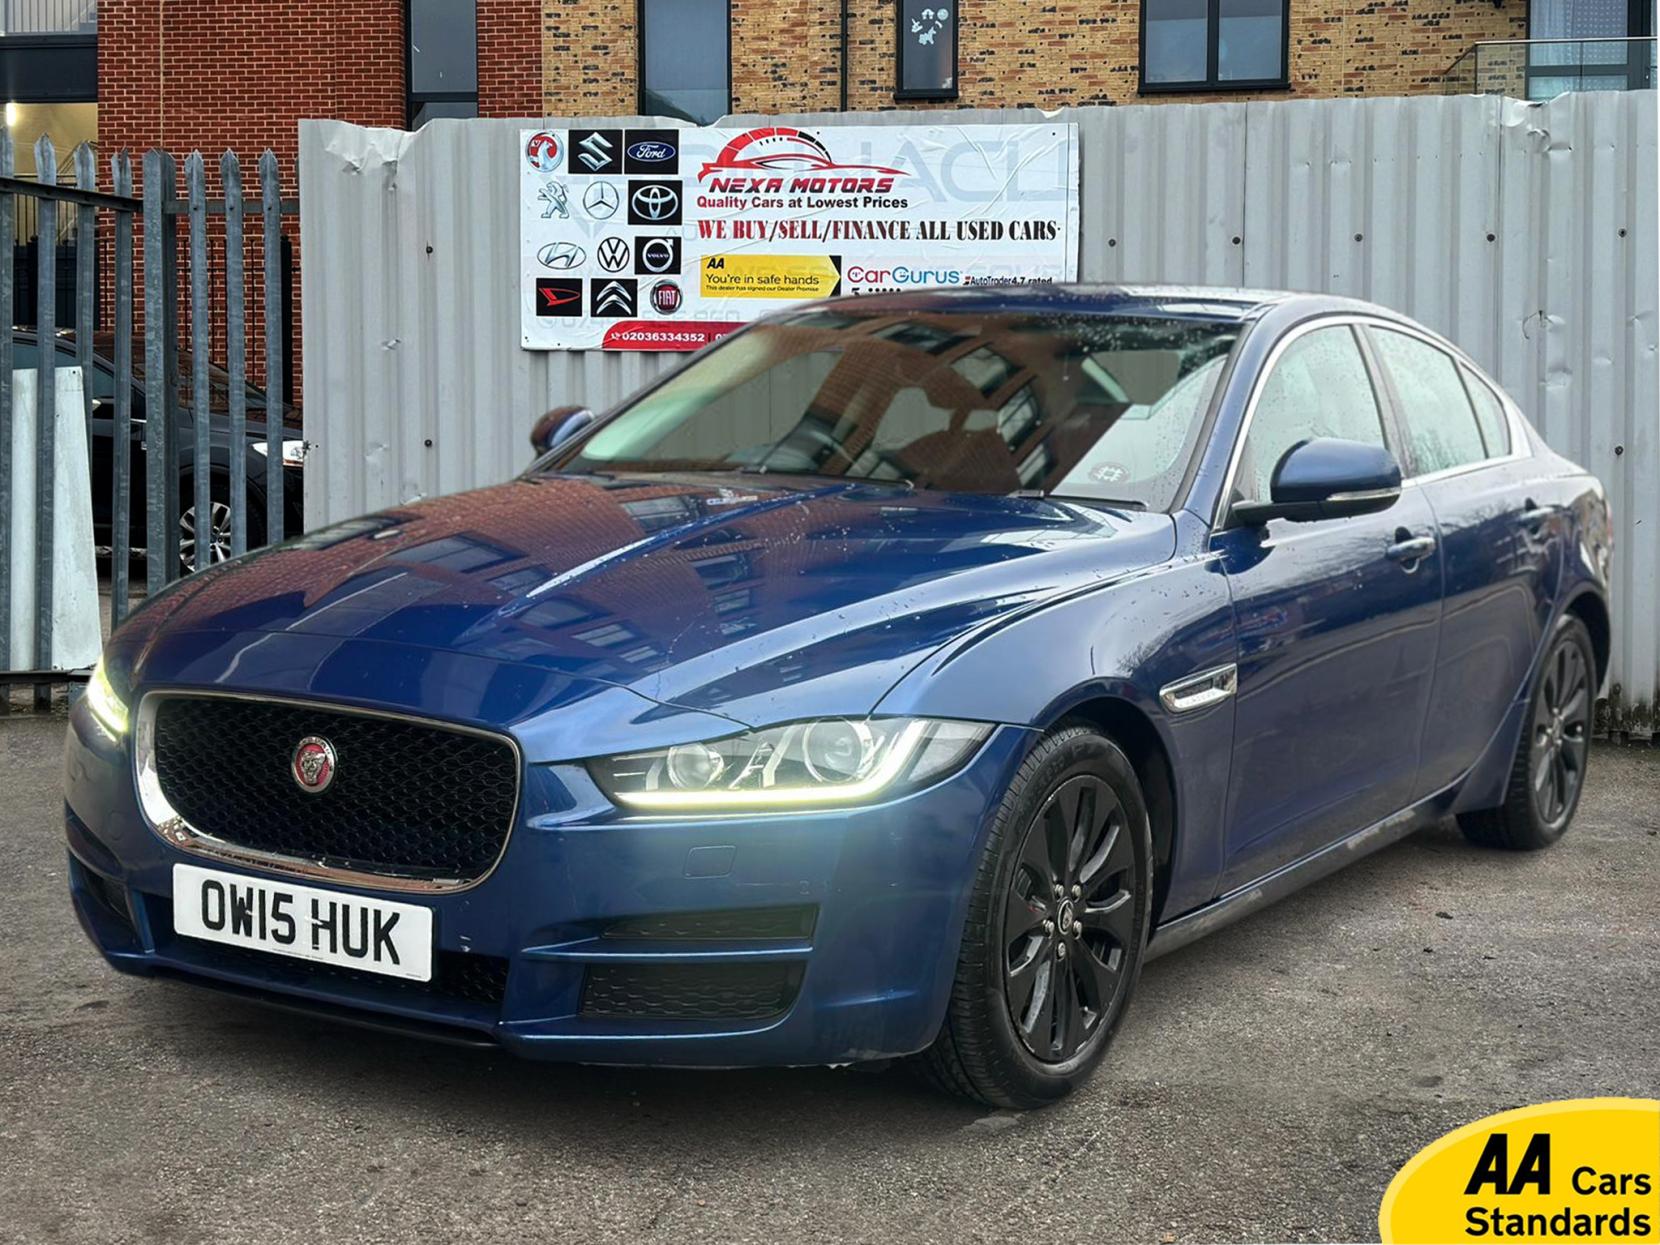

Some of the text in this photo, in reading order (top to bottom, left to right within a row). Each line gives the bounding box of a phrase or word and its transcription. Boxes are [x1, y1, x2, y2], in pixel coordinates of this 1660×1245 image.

[636, 144, 666, 158] Ford
[709, 178, 894, 193] NEXA MOTORS
[697, 196, 908, 210] Quality Cars at Lowest Prices
[698, 220, 727, 239] WE
[916, 220, 950, 240] ALL
[956, 220, 1004, 240] USED
[1008, 220, 1057, 240] CARS
[706, 257, 725, 269] AA
[706, 274, 820, 285] You're in safe hands
[847, 266, 960, 284] CarGurus
[658, 290, 676, 305] FIAT
[622, 332, 705, 342] 02036334352
[201, 879, 401, 965] OW15 HUK
